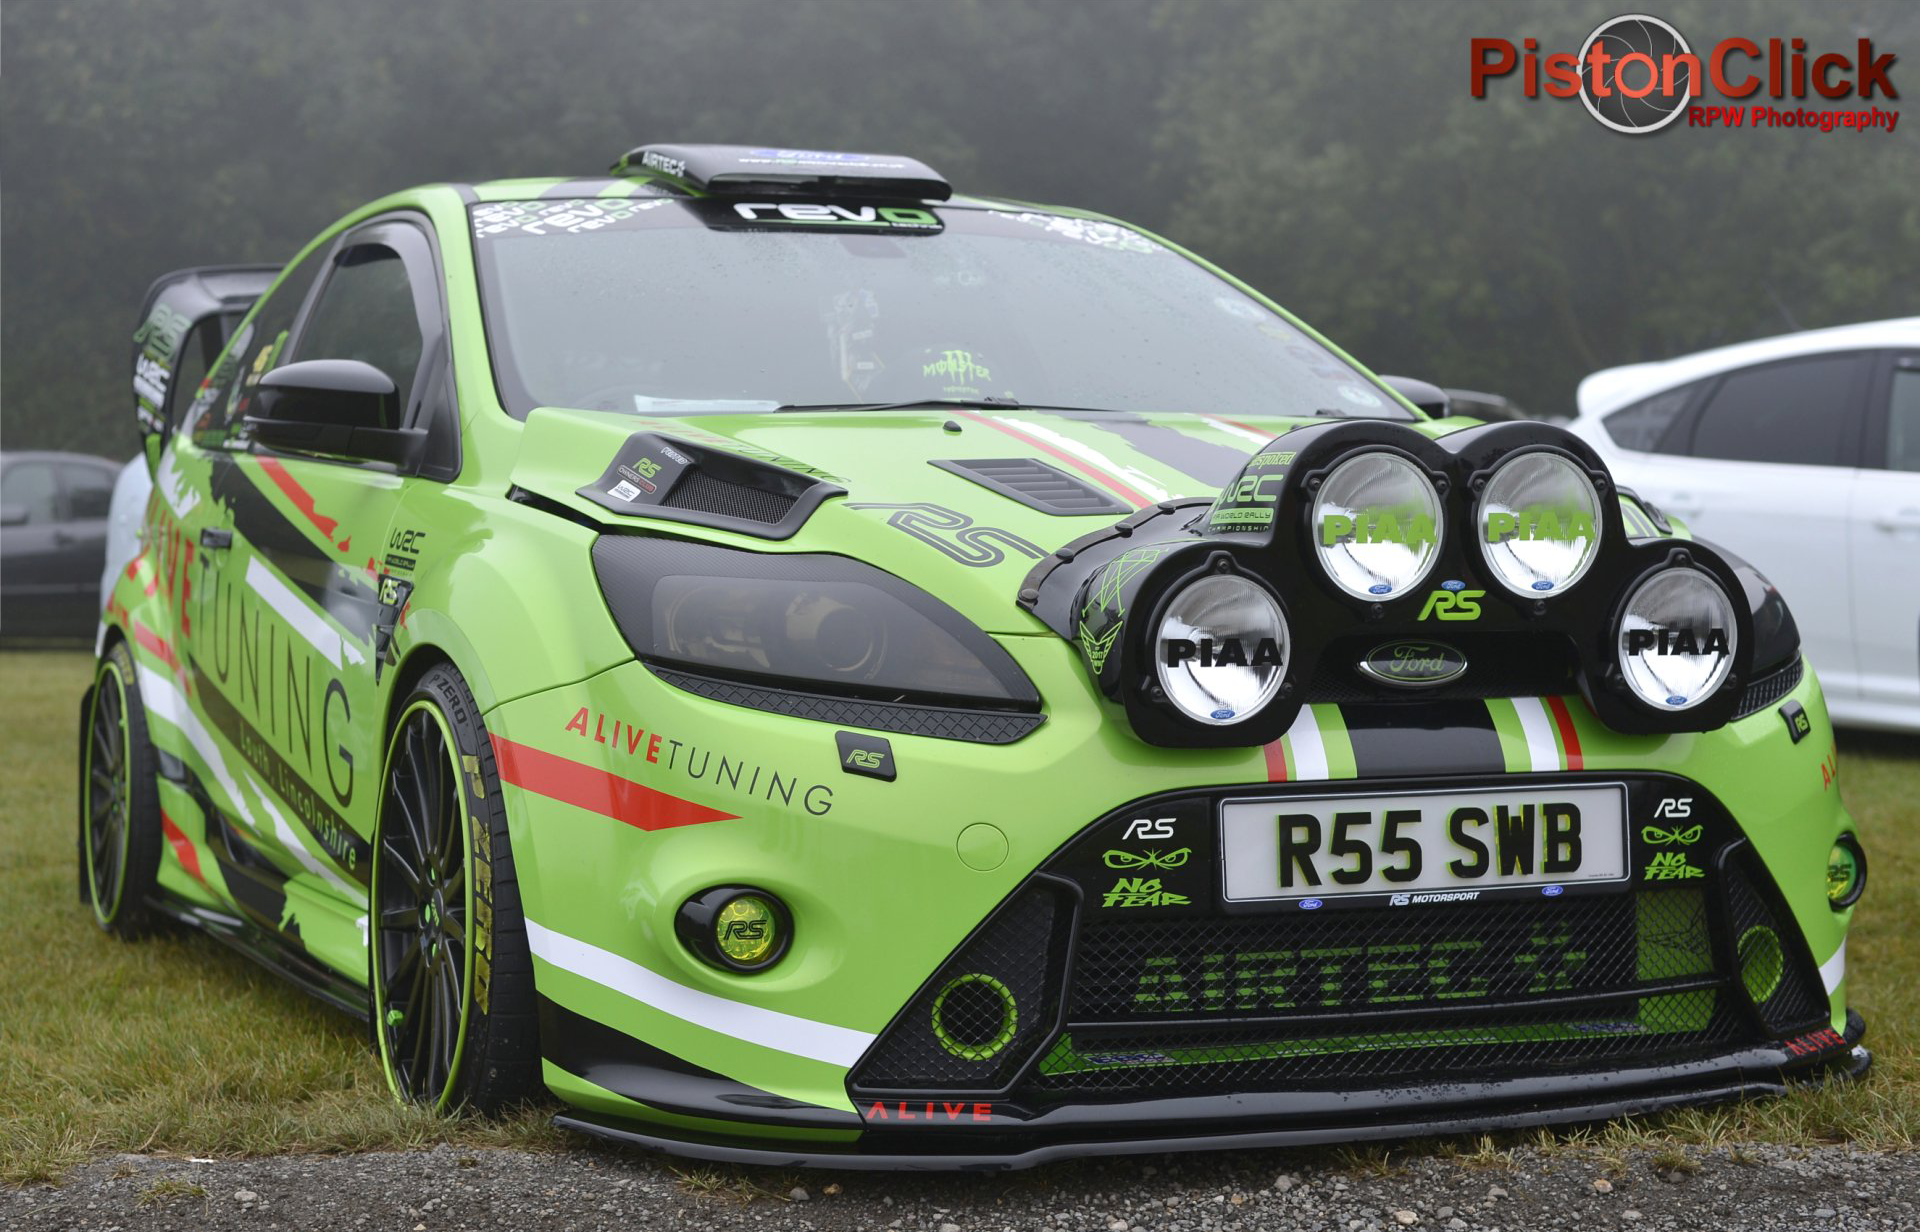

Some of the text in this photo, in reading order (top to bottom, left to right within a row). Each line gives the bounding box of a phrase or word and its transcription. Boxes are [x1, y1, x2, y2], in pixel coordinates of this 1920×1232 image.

[733, 203, 938, 225] revo
[632, 457, 662, 478] RS
[841, 502, 1050, 568] RS
[1324, 513, 1436, 545] PIAA
[1487, 512, 1596, 542] PIAA
[1417, 590, 1486, 621] RS
[1167, 637, 1283, 668] PIAA
[1628, 628, 1730, 656] PIAA
[1390, 645, 1445, 672] Ford
[437, 678, 467, 724] ZERO
[846, 749, 884, 769] RS
[1654, 798, 1693, 818] RS
[1122, 818, 1177, 840] RS
[1276, 802, 1583, 888] R55 SWB
[1651, 852, 1687, 867] NO
[1644, 864, 1705, 880] FEAR
[1110, 877, 1163, 894] NO
[1102, 890, 1192, 908] FEAR
[1389, 891, 1480, 906] RS MOTORSPORT
[723, 919, 768, 940] RS
[1784, 1029, 1846, 1056] ALIVE
[866, 1101, 993, 1121] ALIVE
